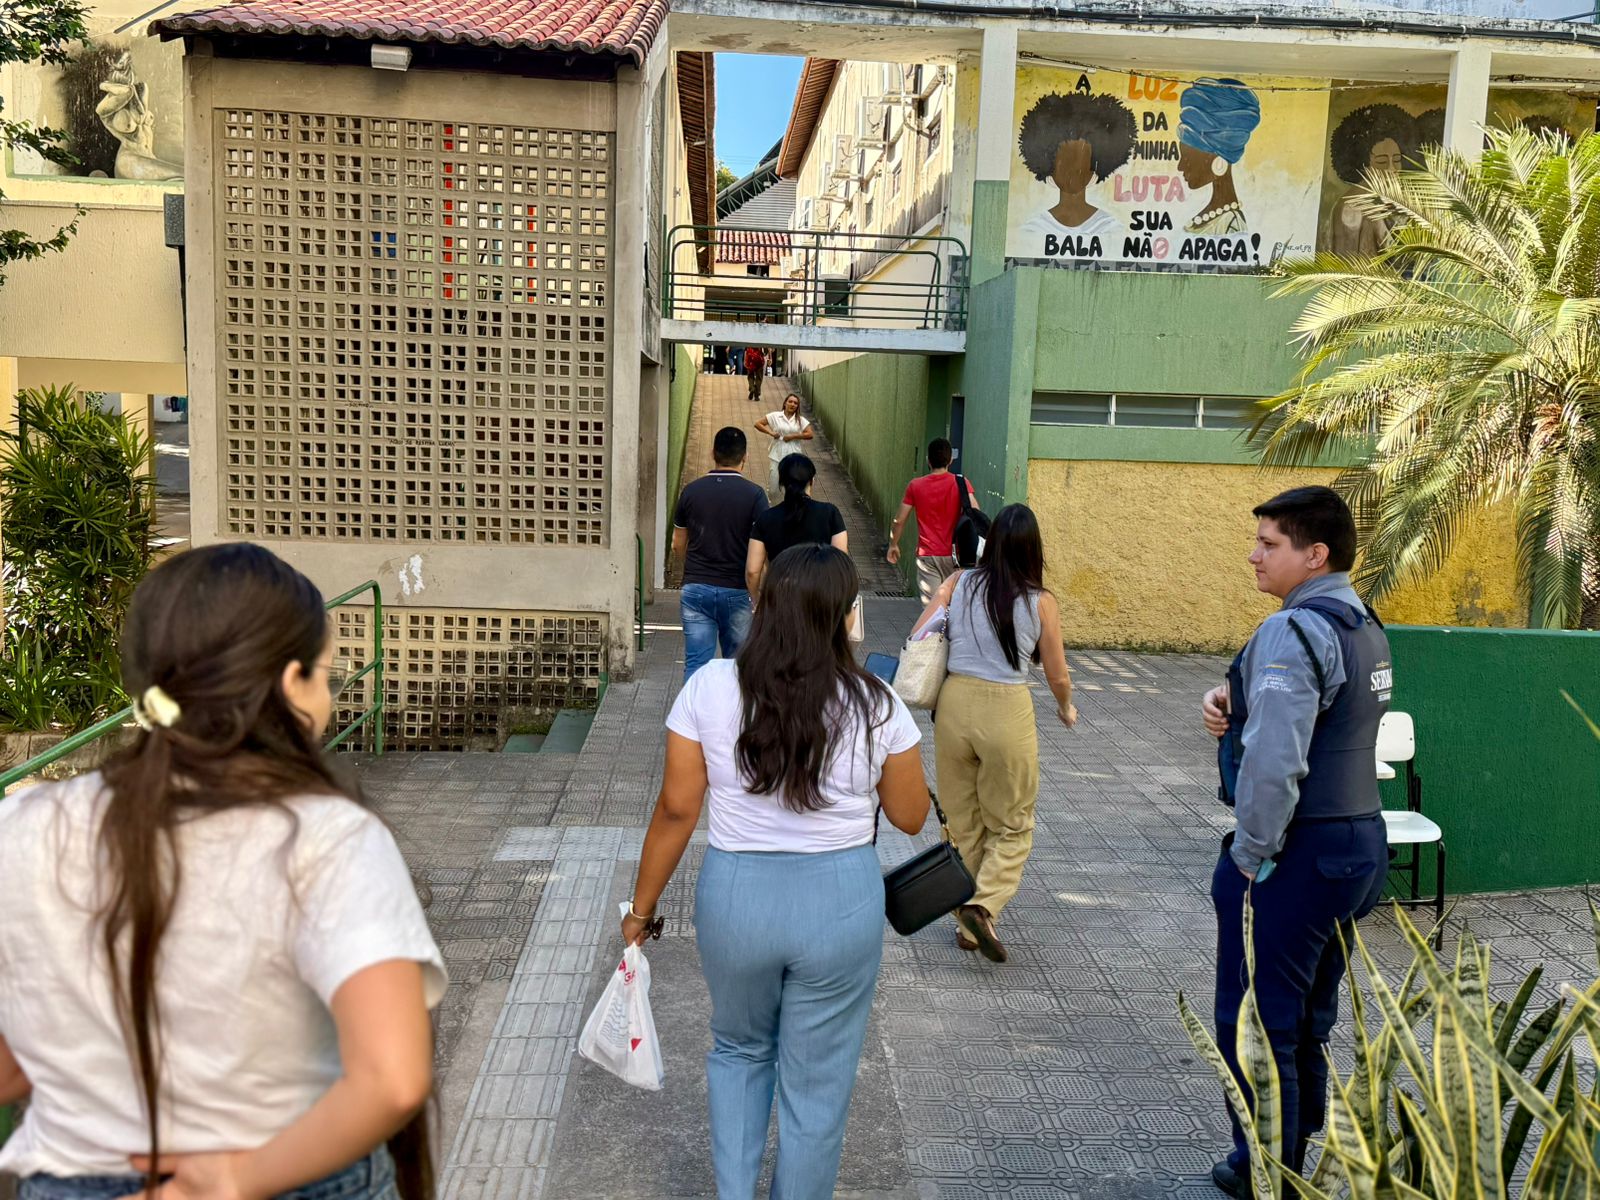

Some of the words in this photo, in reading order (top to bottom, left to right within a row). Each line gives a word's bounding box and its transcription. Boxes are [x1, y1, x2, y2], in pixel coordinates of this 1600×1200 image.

[1076, 74, 1091, 94] A
[1128, 72, 1179, 101] LUZ
[1143, 111, 1168, 132] DA
[1132, 140, 1180, 161] MINHA
[1114, 174, 1185, 202] LUTA
[1129, 210, 1173, 231] SUA
[1044, 234, 1103, 258] BALA
[1122, 232, 1170, 260] NÃO
